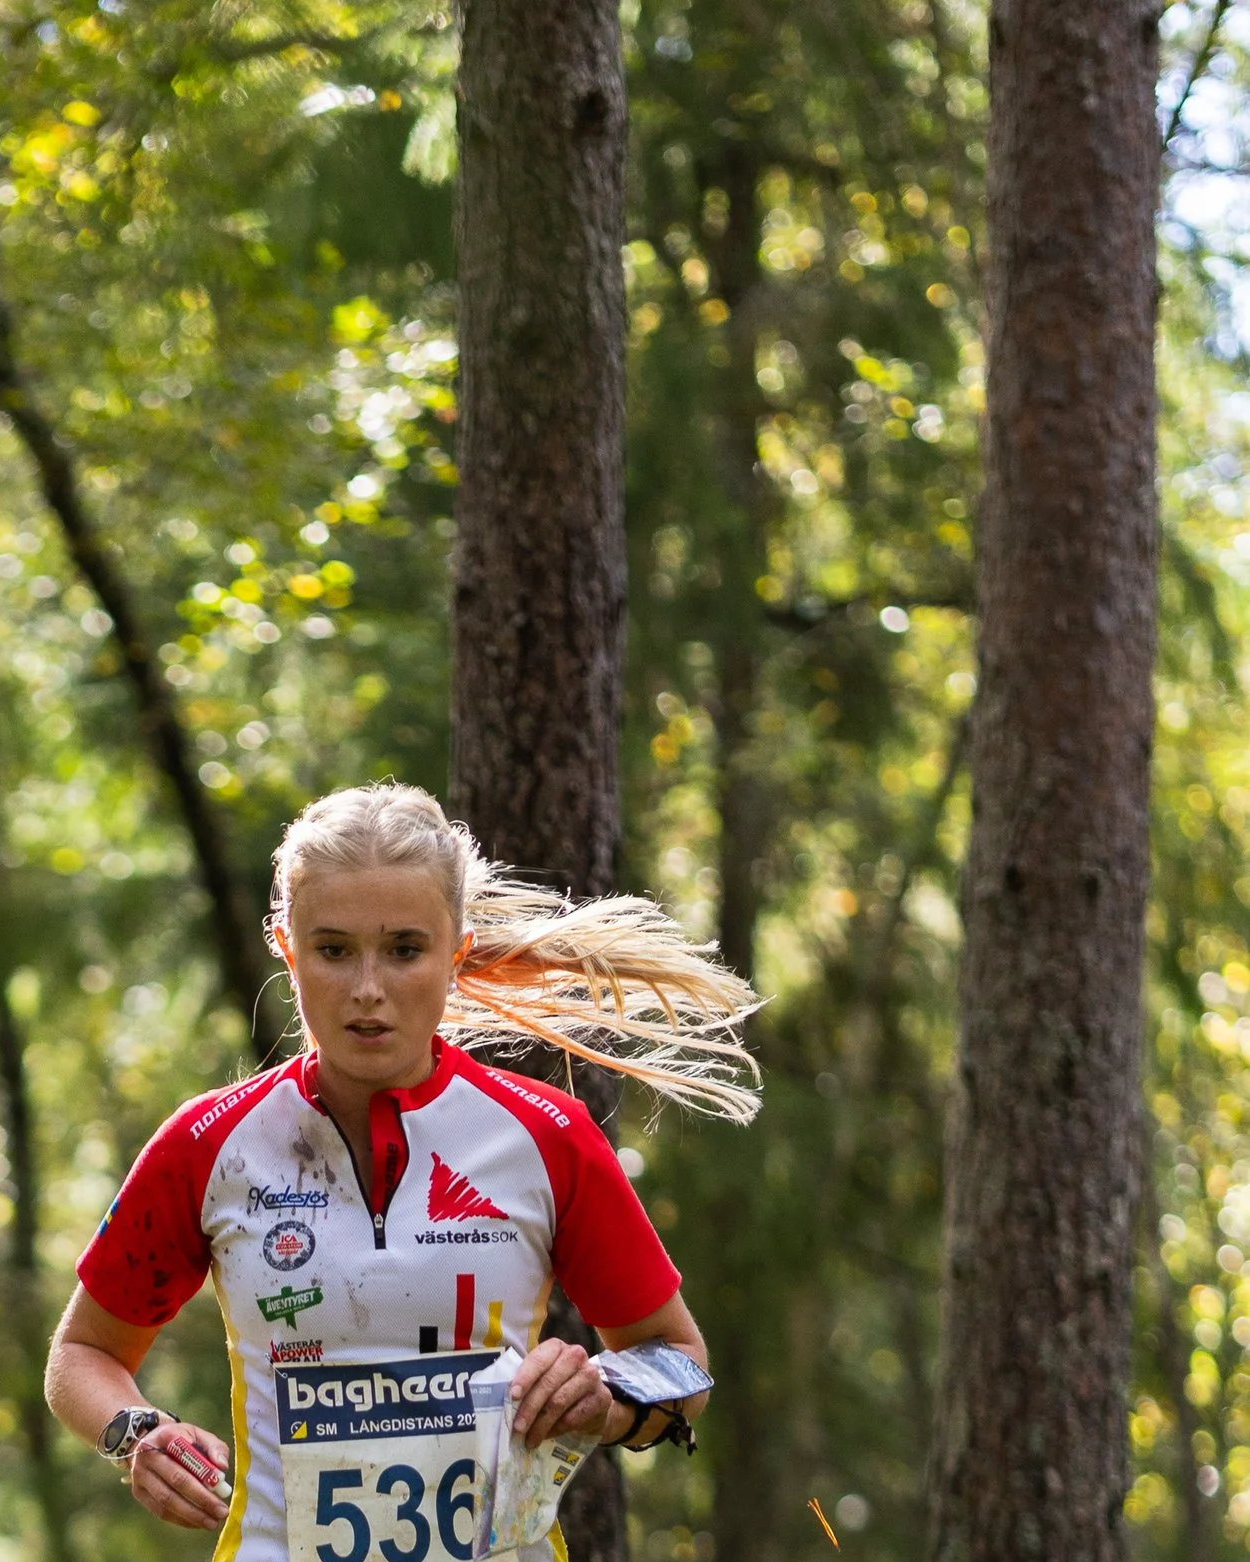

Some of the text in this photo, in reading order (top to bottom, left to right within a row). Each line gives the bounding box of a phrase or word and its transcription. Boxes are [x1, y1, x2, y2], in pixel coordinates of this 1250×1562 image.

[485, 1069, 571, 1128] noname
[280, 1346, 324, 1361] POWER
[287, 1370, 478, 1413] bagheer
[316, 1413, 476, 1436] SM LÅNGDISTANS 202
